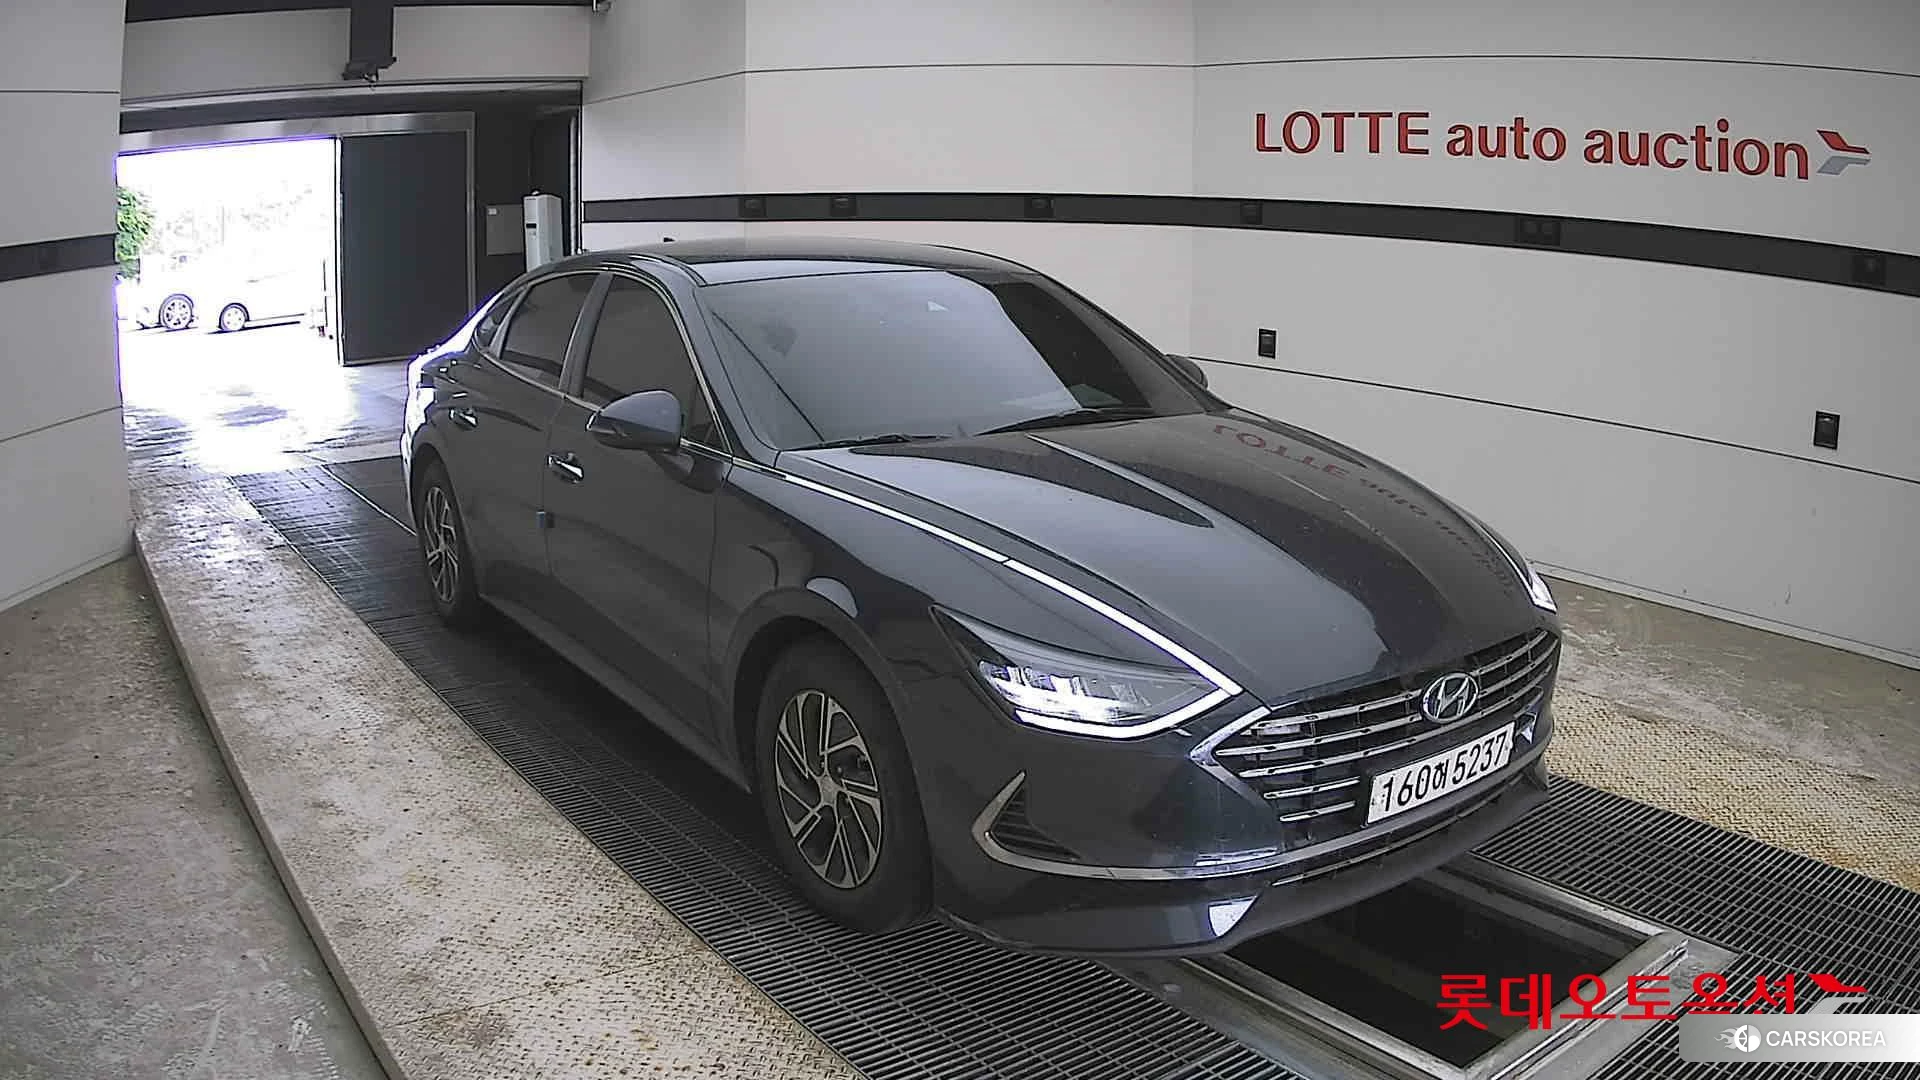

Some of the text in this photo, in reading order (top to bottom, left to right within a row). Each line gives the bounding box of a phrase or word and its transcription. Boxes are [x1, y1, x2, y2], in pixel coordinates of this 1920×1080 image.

[1255, 111, 1810, 180] LOTTE auto auction
